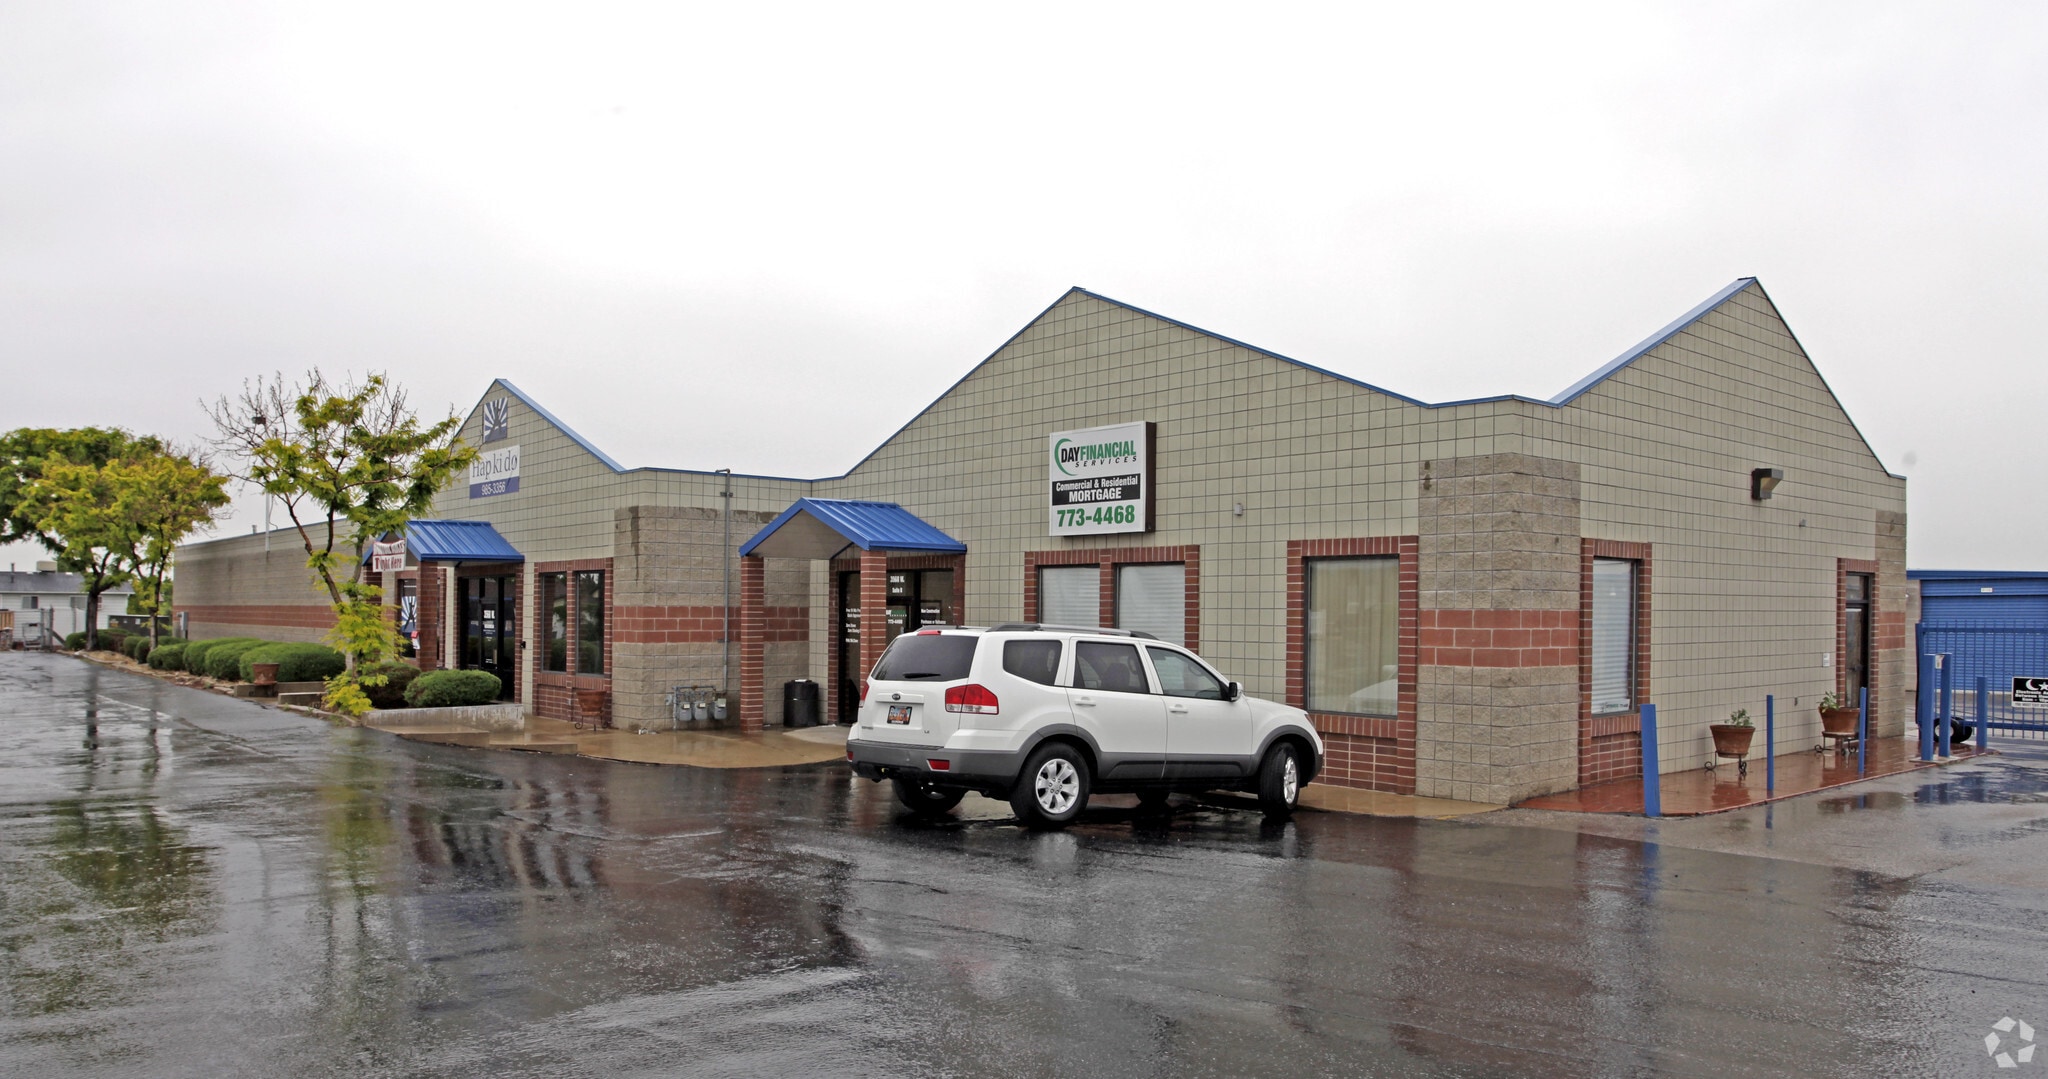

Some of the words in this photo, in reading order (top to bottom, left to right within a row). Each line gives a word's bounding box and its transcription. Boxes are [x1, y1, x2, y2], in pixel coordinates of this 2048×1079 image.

[1075, 456, 1137, 468] SERVICES
[1056, 480, 1092, 491] Commercial
[1094, 479, 1099, 488] &
[1101, 476, 1138, 488] Residential
[1069, 488, 1121, 503] MORTGAGE
[1057, 505, 1135, 527] 773-4468
